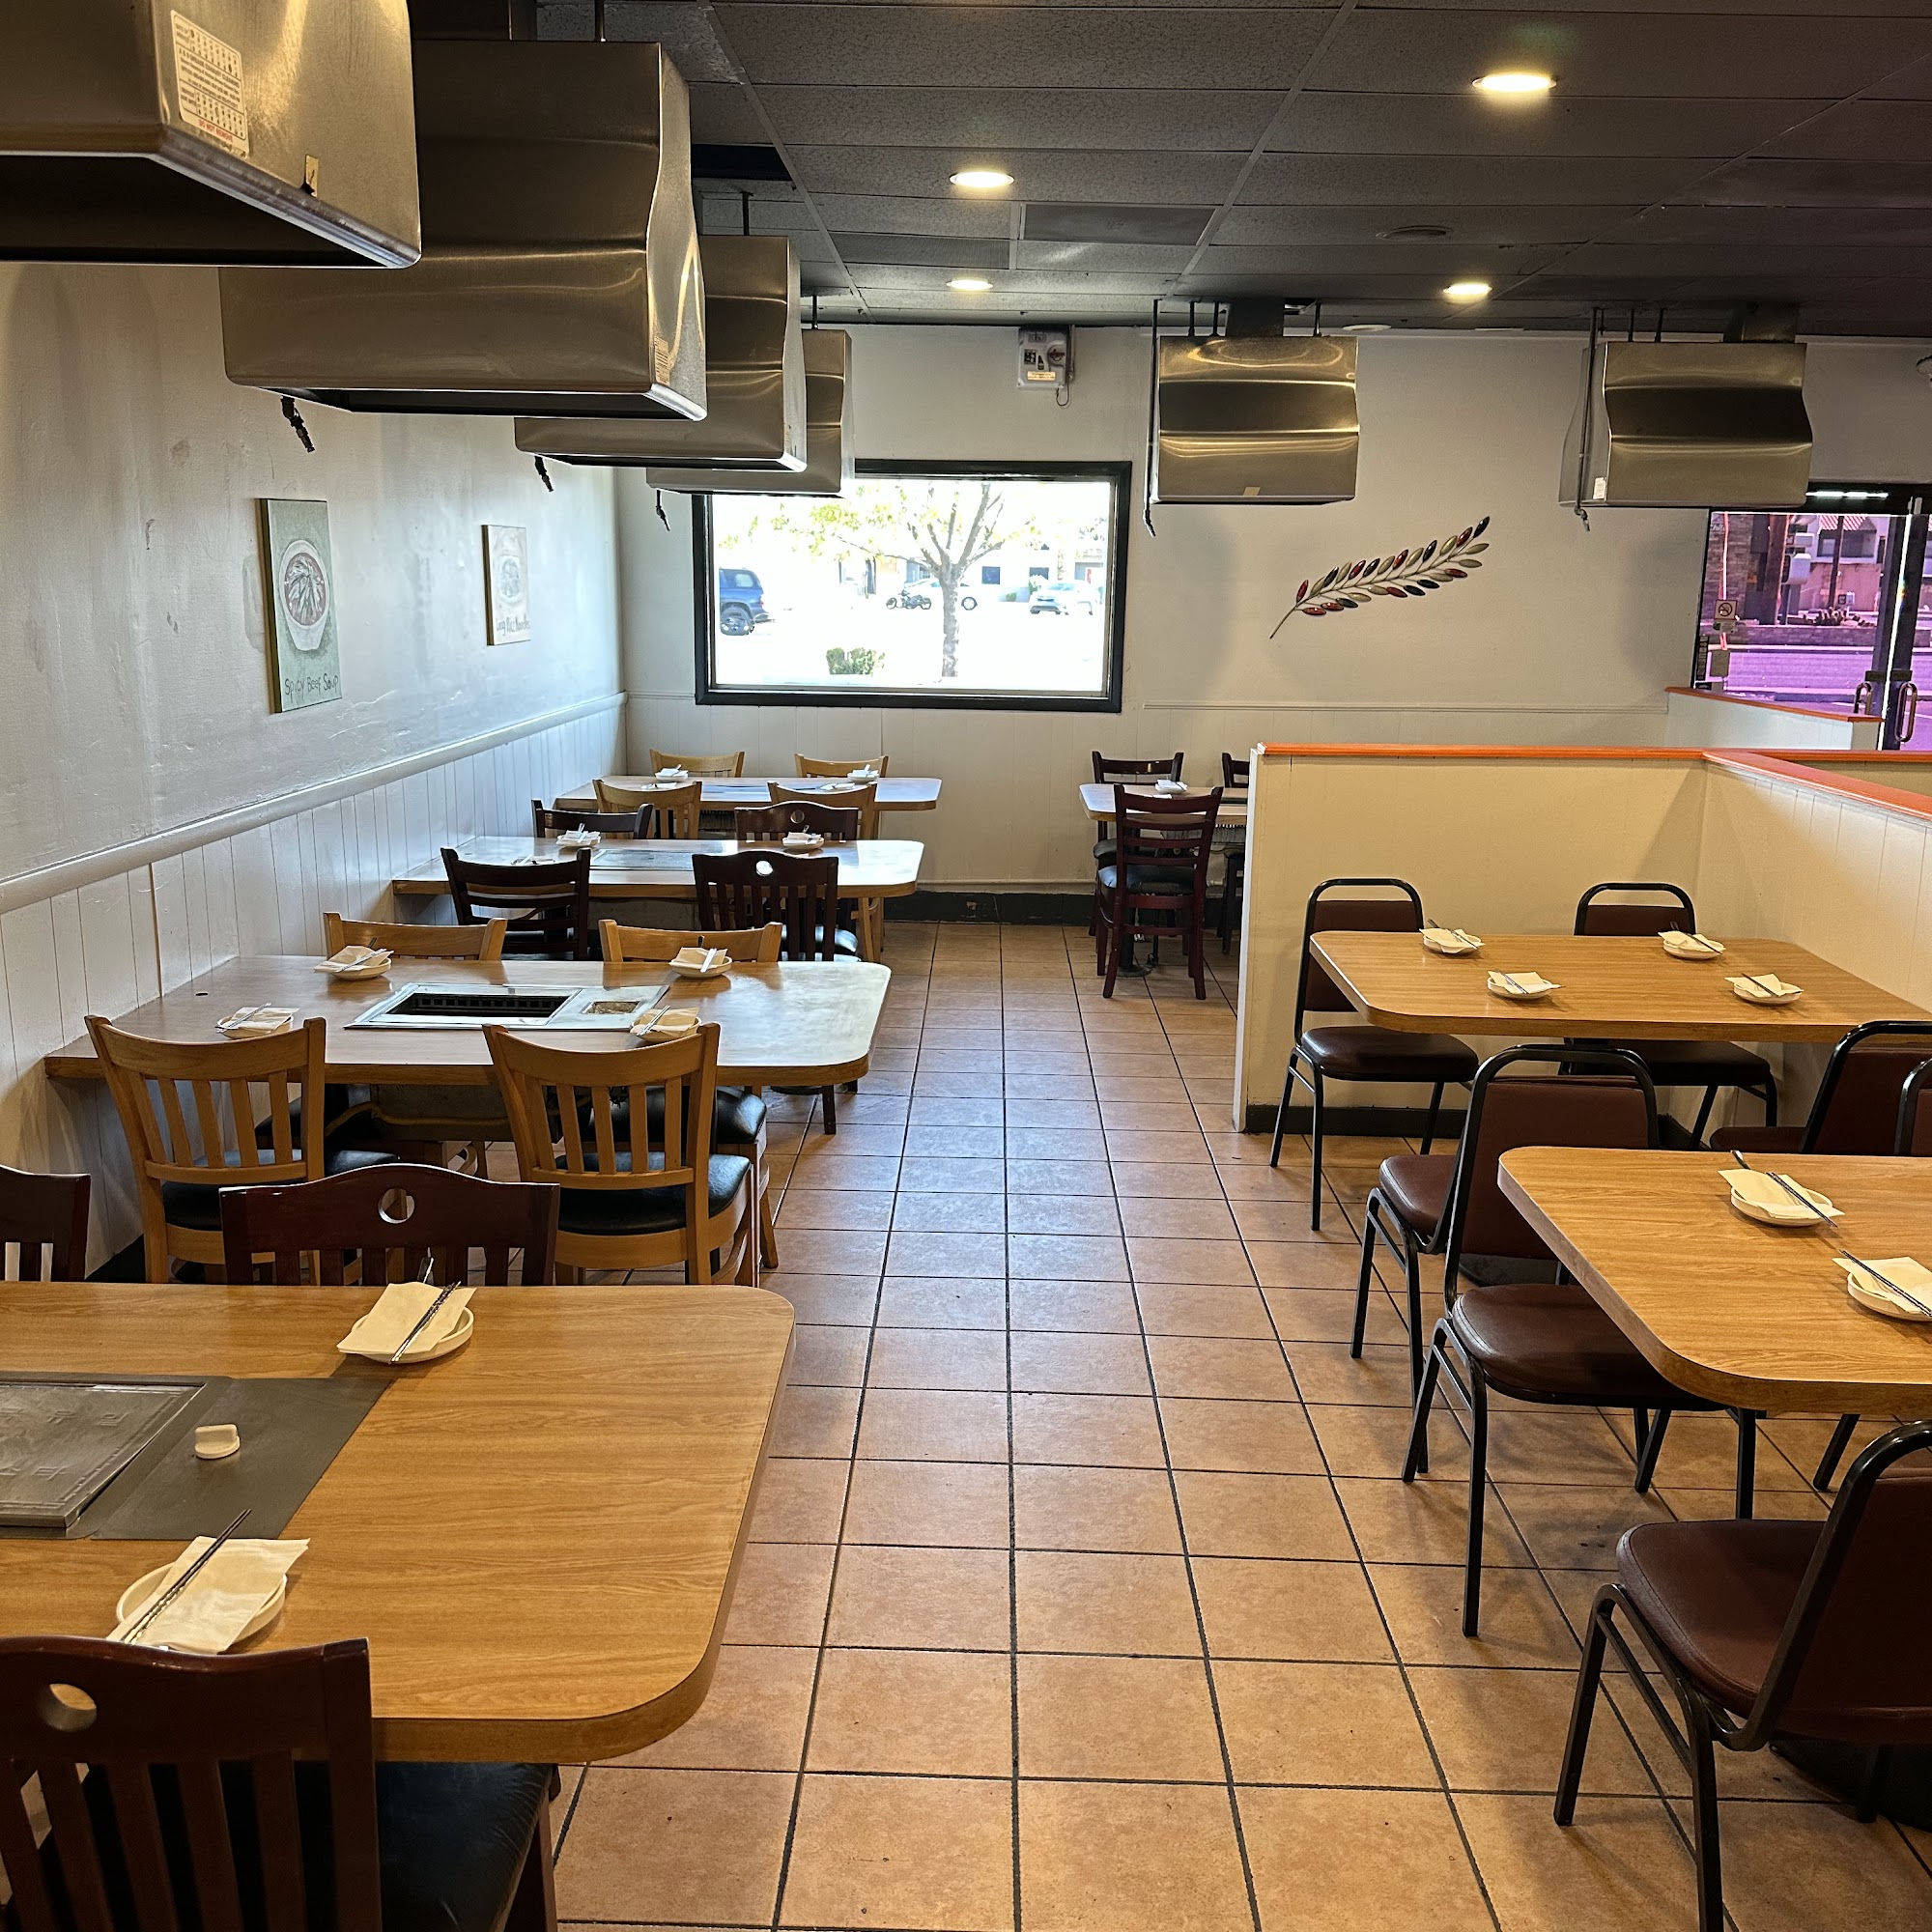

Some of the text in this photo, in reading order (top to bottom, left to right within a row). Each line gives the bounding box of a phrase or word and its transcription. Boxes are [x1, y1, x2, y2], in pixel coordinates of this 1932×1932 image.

[285, 673, 339, 705] Spicy Beef Soup
